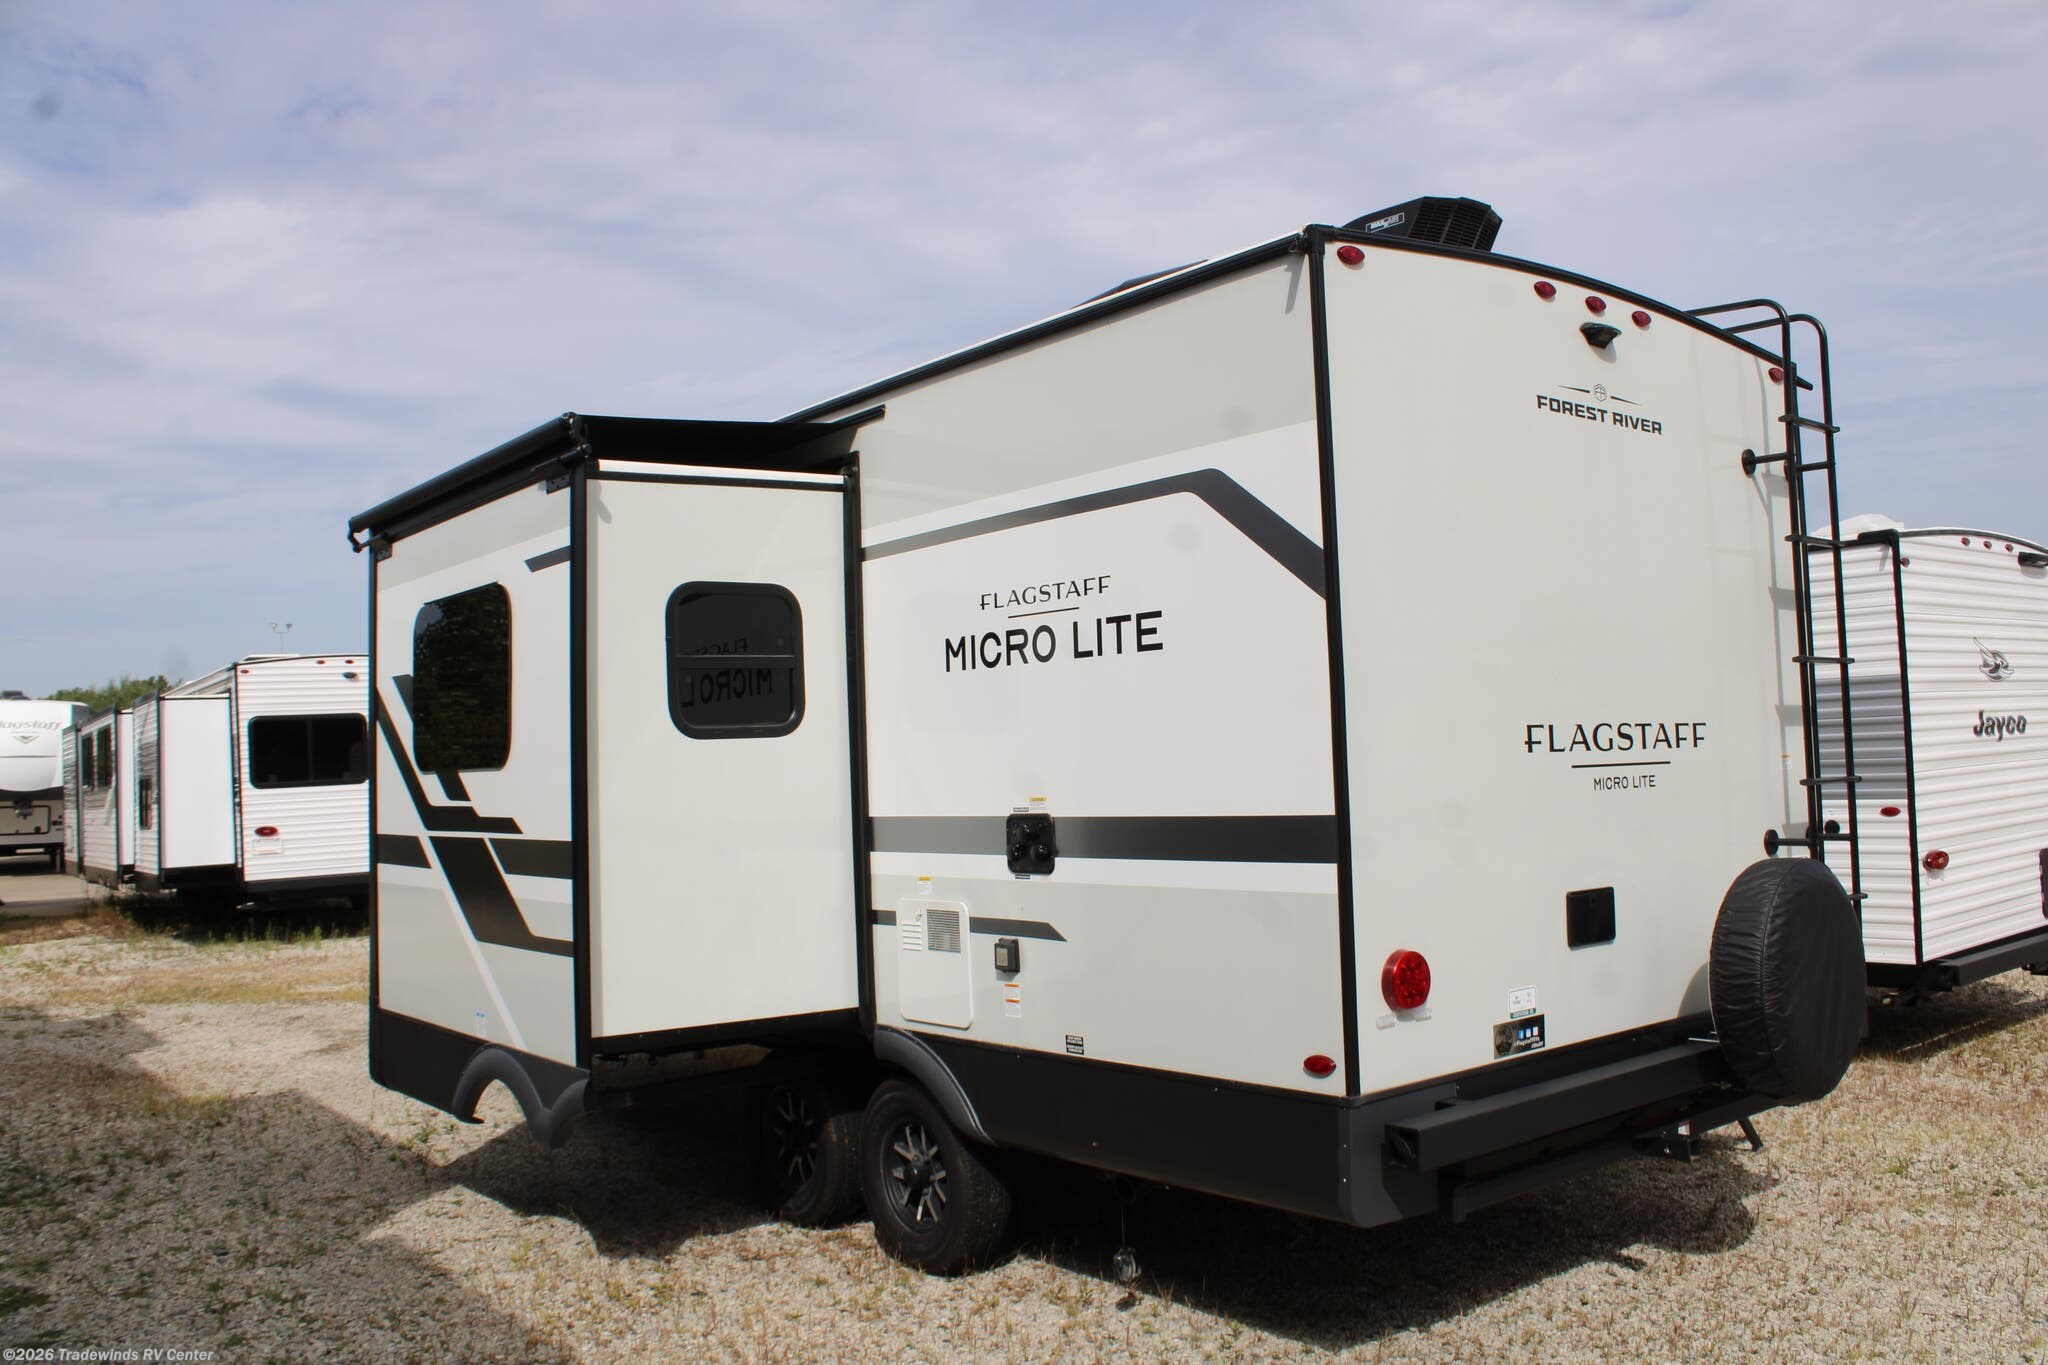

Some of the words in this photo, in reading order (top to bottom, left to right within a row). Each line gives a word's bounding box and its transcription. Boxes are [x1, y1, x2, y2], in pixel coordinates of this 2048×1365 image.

[1536, 394, 1608, 423] FOREST
[1612, 411, 1662, 435] RIVER
[980, 575, 1111, 610] FLAGSTAFF
[945, 624, 1057, 673] MICRO
[1073, 610, 1164, 659] LITE
[1524, 722, 1707, 753] FLAGSTAFF
[1973, 709, 2027, 742] Jayco
[1593, 776, 1629, 791] MICRO
[1632, 774, 1656, 789] LITE
